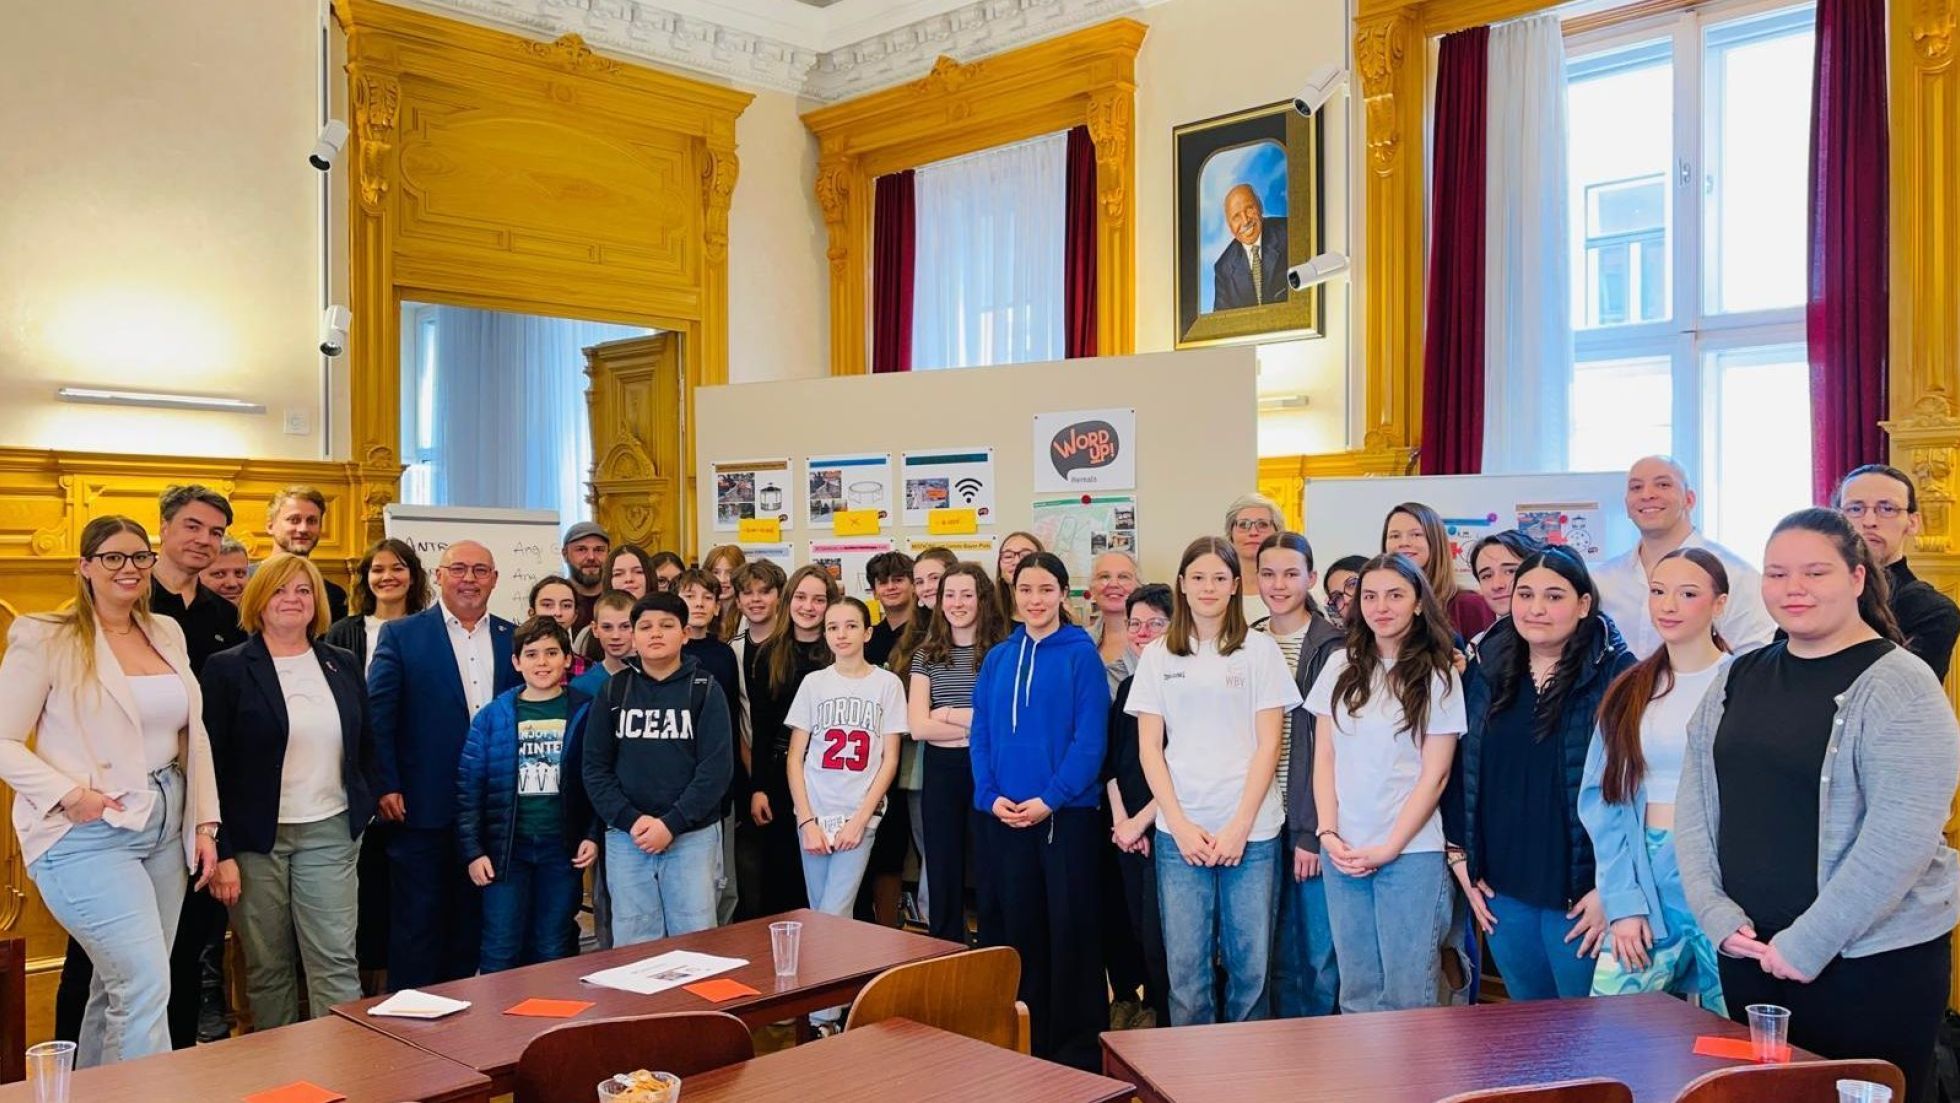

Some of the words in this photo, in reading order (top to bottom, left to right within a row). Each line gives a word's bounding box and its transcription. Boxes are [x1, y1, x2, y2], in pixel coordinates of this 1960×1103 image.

[1053, 428, 1110, 459] WORD
[1089, 442, 1115, 463] UP!
[821, 728, 871, 772] 23
